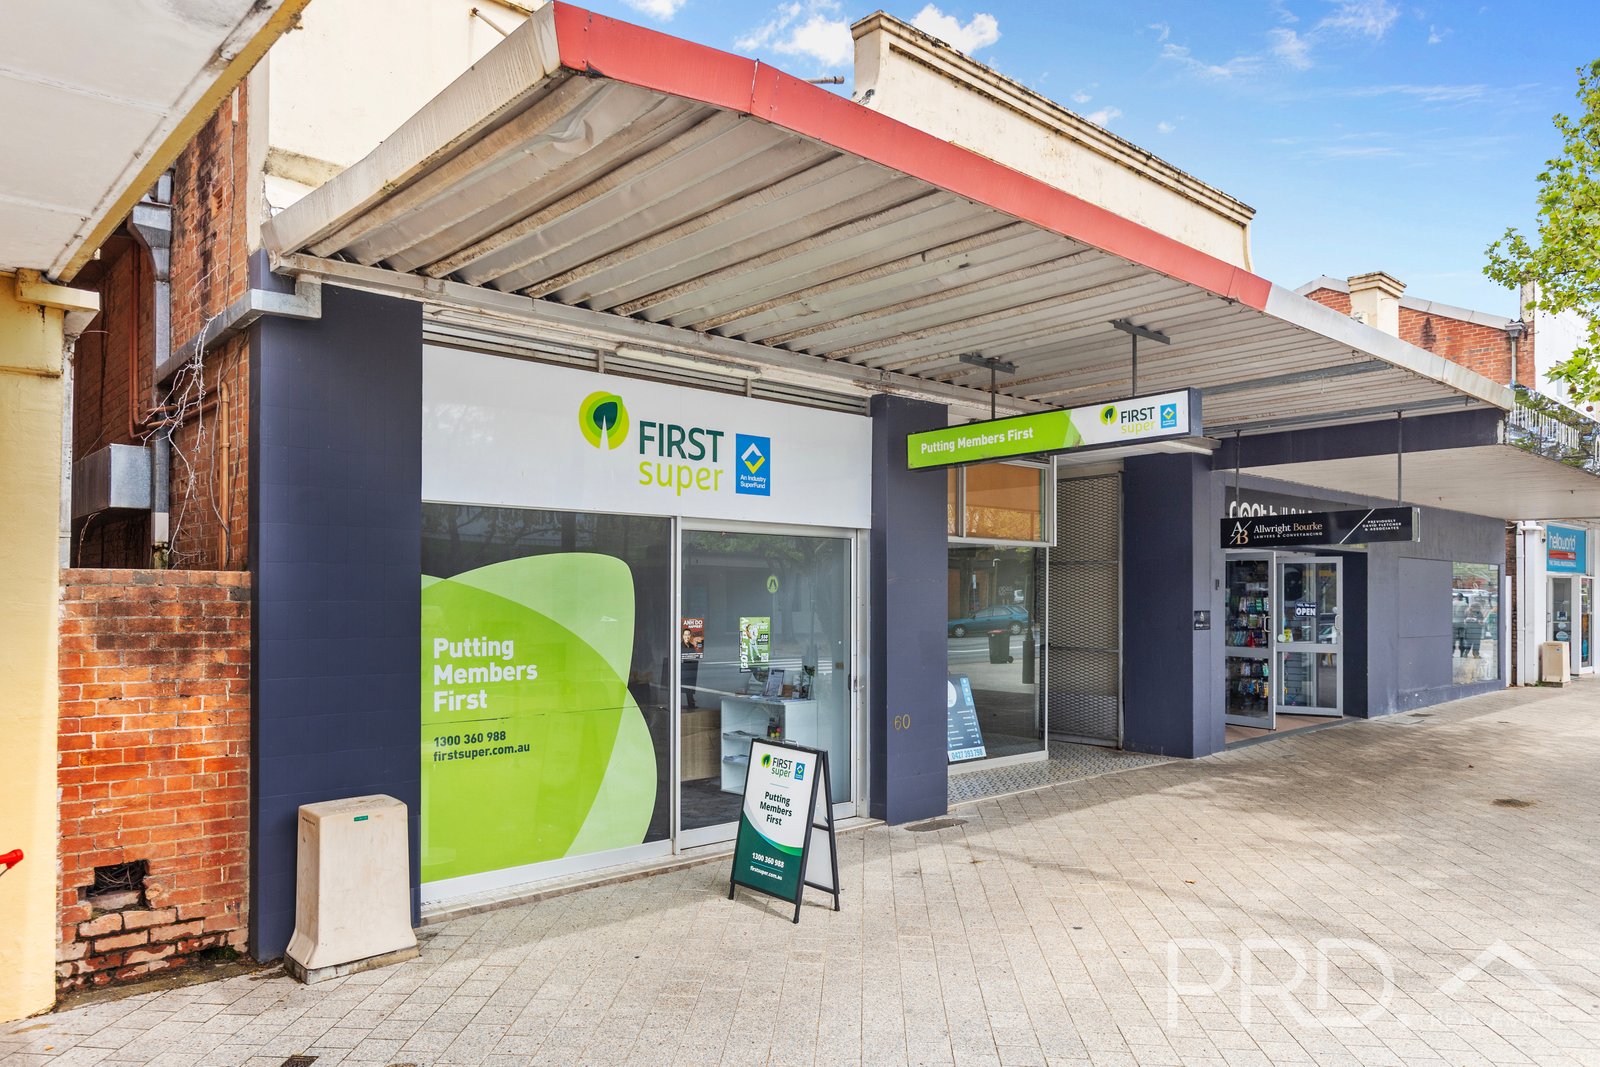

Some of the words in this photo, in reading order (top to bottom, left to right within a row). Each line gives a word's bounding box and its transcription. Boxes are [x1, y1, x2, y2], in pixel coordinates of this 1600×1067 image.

[1120, 406, 1155, 423] FIRST
[1120, 420, 1155, 435] super
[639, 420, 724, 463] FIRST
[921, 440, 955, 454] Putting
[957, 433, 1005, 449] Members
[1007, 427, 1034, 441] First
[639, 461, 724, 496] super
[740, 481, 766, 489] SuperFund
[748, 475, 766, 484] Industry
[1253, 523, 1292, 534] Allwright
[1293, 521, 1323, 531] Bourke
[1296, 607, 1316, 616] OPEN
[433, 636, 514, 660] Putting
[433, 662, 538, 686] Members
[433, 689, 488, 713] First
[894, 714, 911, 730] 60
[433, 735, 461, 748] 1300
[464, 732, 484, 745] 360
[487, 730, 506, 743] 988
[433, 743, 531, 762] firstsuper.com.au
[772, 757, 793, 770] FIRST
[771, 767, 792, 778] super
[764, 791, 791, 807] Putting
[759, 801, 793, 817] Members
[766, 814, 782, 826] First
[752, 852, 764, 862] 1300
[764, 855, 775, 865] 360
[774, 859, 785, 868] 988
[750, 865, 783, 880] firstsuper.com.au
